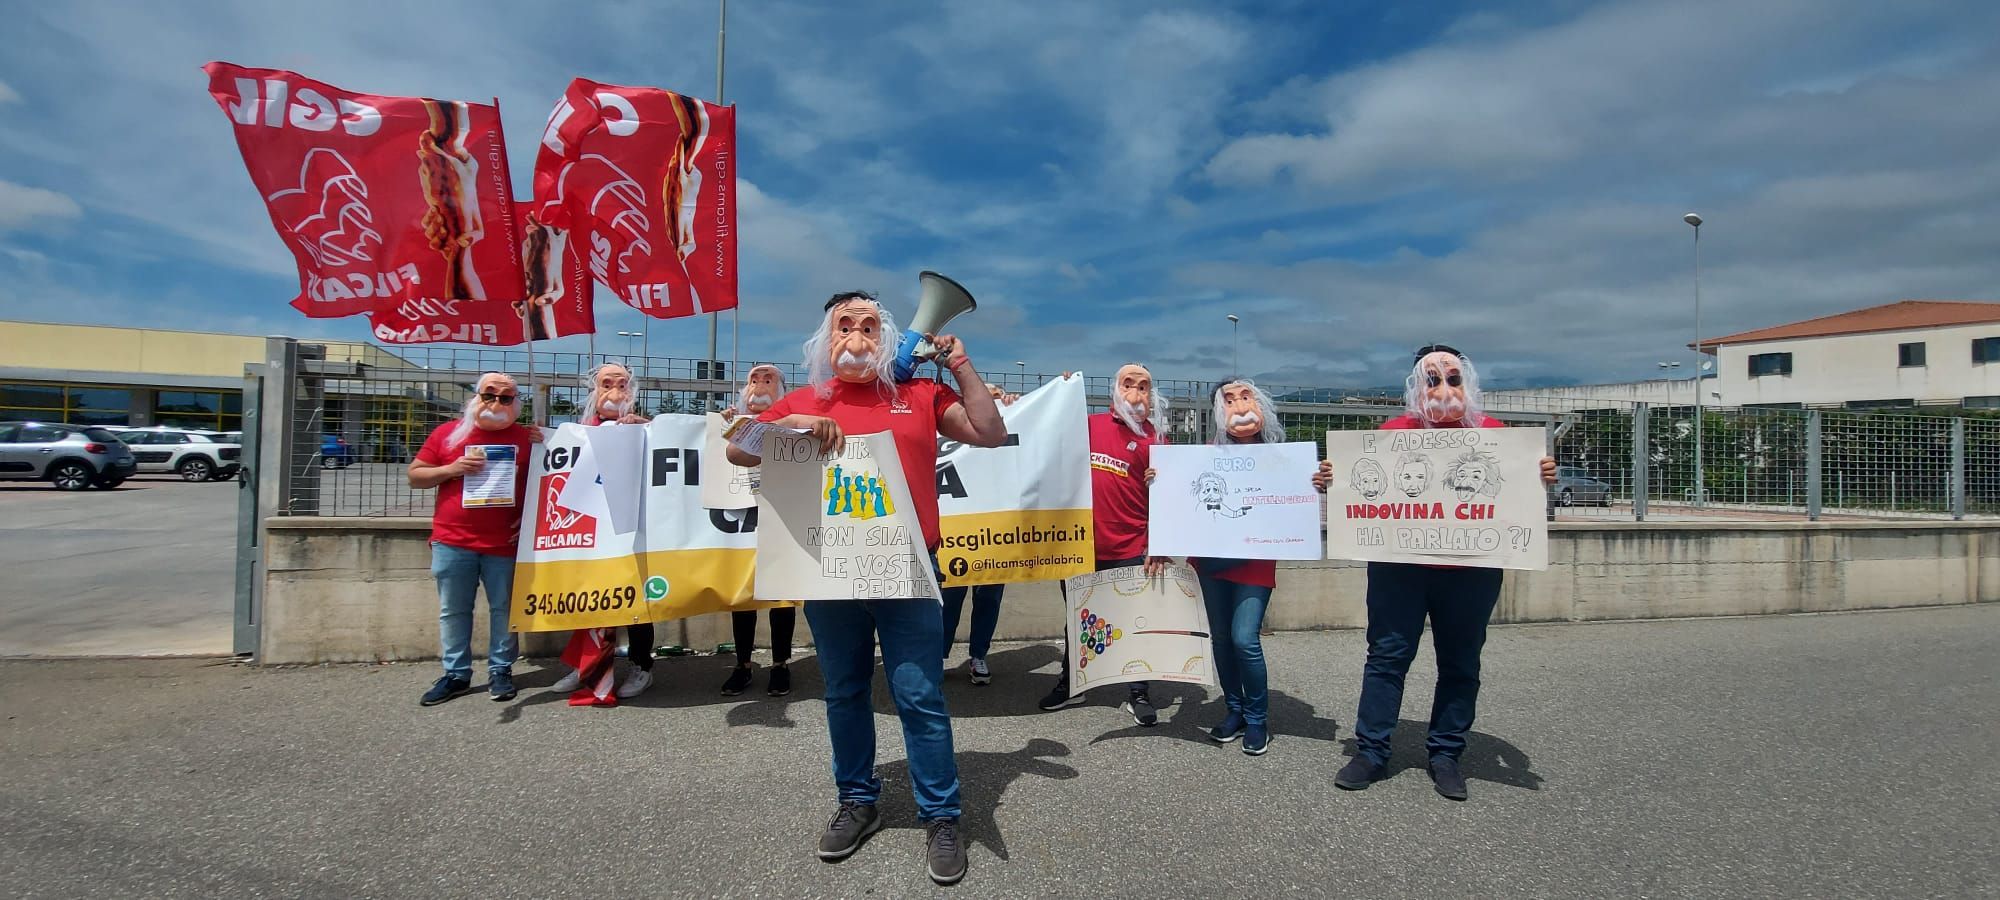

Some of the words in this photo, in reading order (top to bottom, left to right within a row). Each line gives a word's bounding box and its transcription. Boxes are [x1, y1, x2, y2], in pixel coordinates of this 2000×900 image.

[774, 437, 812, 463] NO
[1362, 434, 1376, 453] E
[1213, 457, 1255, 472] EURO
[1346, 502, 1444, 520] INDOVINA
[1455, 502, 1495, 520] CHI
[536, 533, 593, 548] FILCAMS
[806, 526, 854, 546] NON
[1356, 527, 1384, 546] HA
[1397, 527, 1500, 551] PARLATO
[823, 557, 848, 578] LE
[972, 554, 1084, 571] @filcamscgilcalabria
[853, 578, 931, 599] PEDINE
[524, 586, 636, 615] 345.6003659
